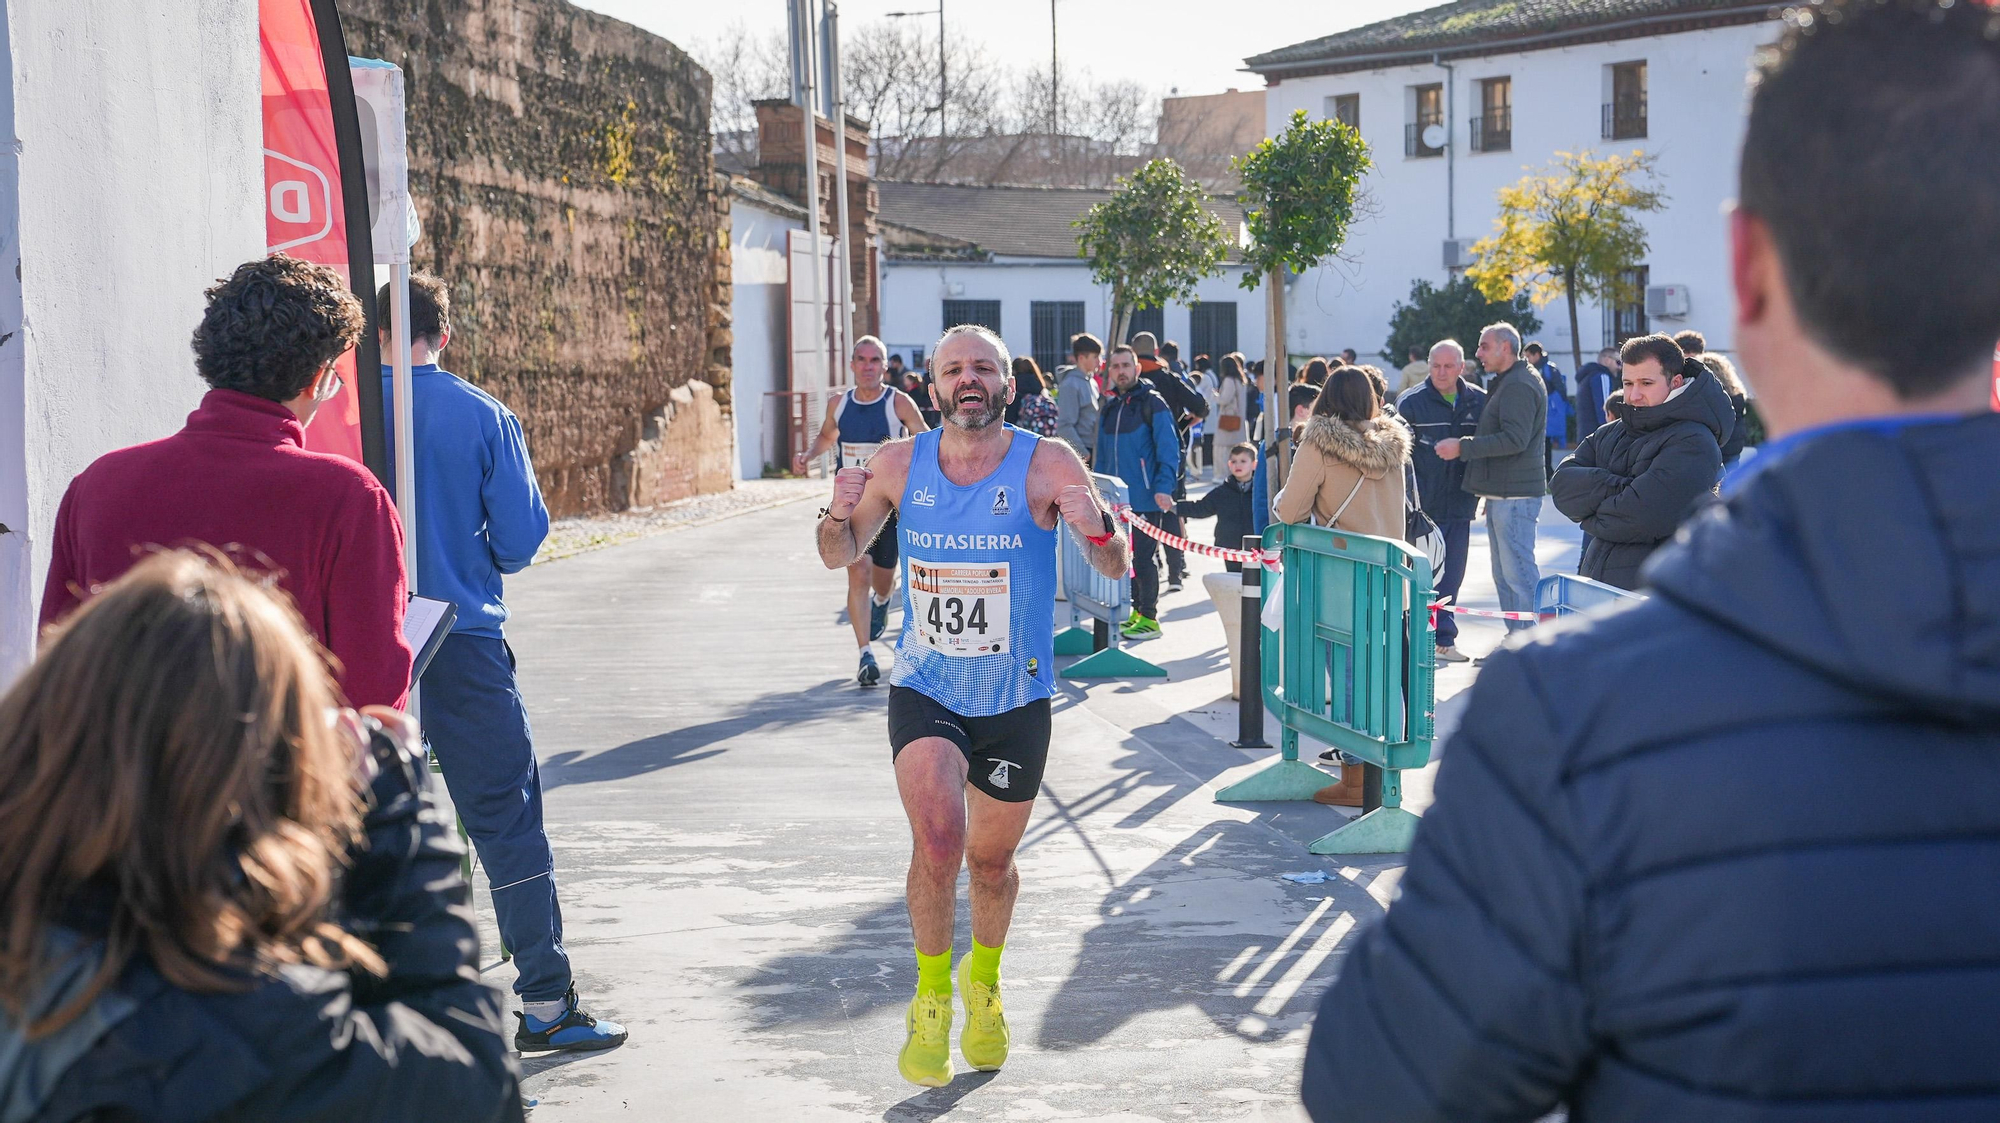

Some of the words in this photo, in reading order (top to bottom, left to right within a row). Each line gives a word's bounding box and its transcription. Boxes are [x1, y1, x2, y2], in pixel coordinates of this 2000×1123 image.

[905, 528, 1024, 550] TROTASIERRA
[951, 569, 972, 577] CARRERA
[927, 597, 988, 635] 434
